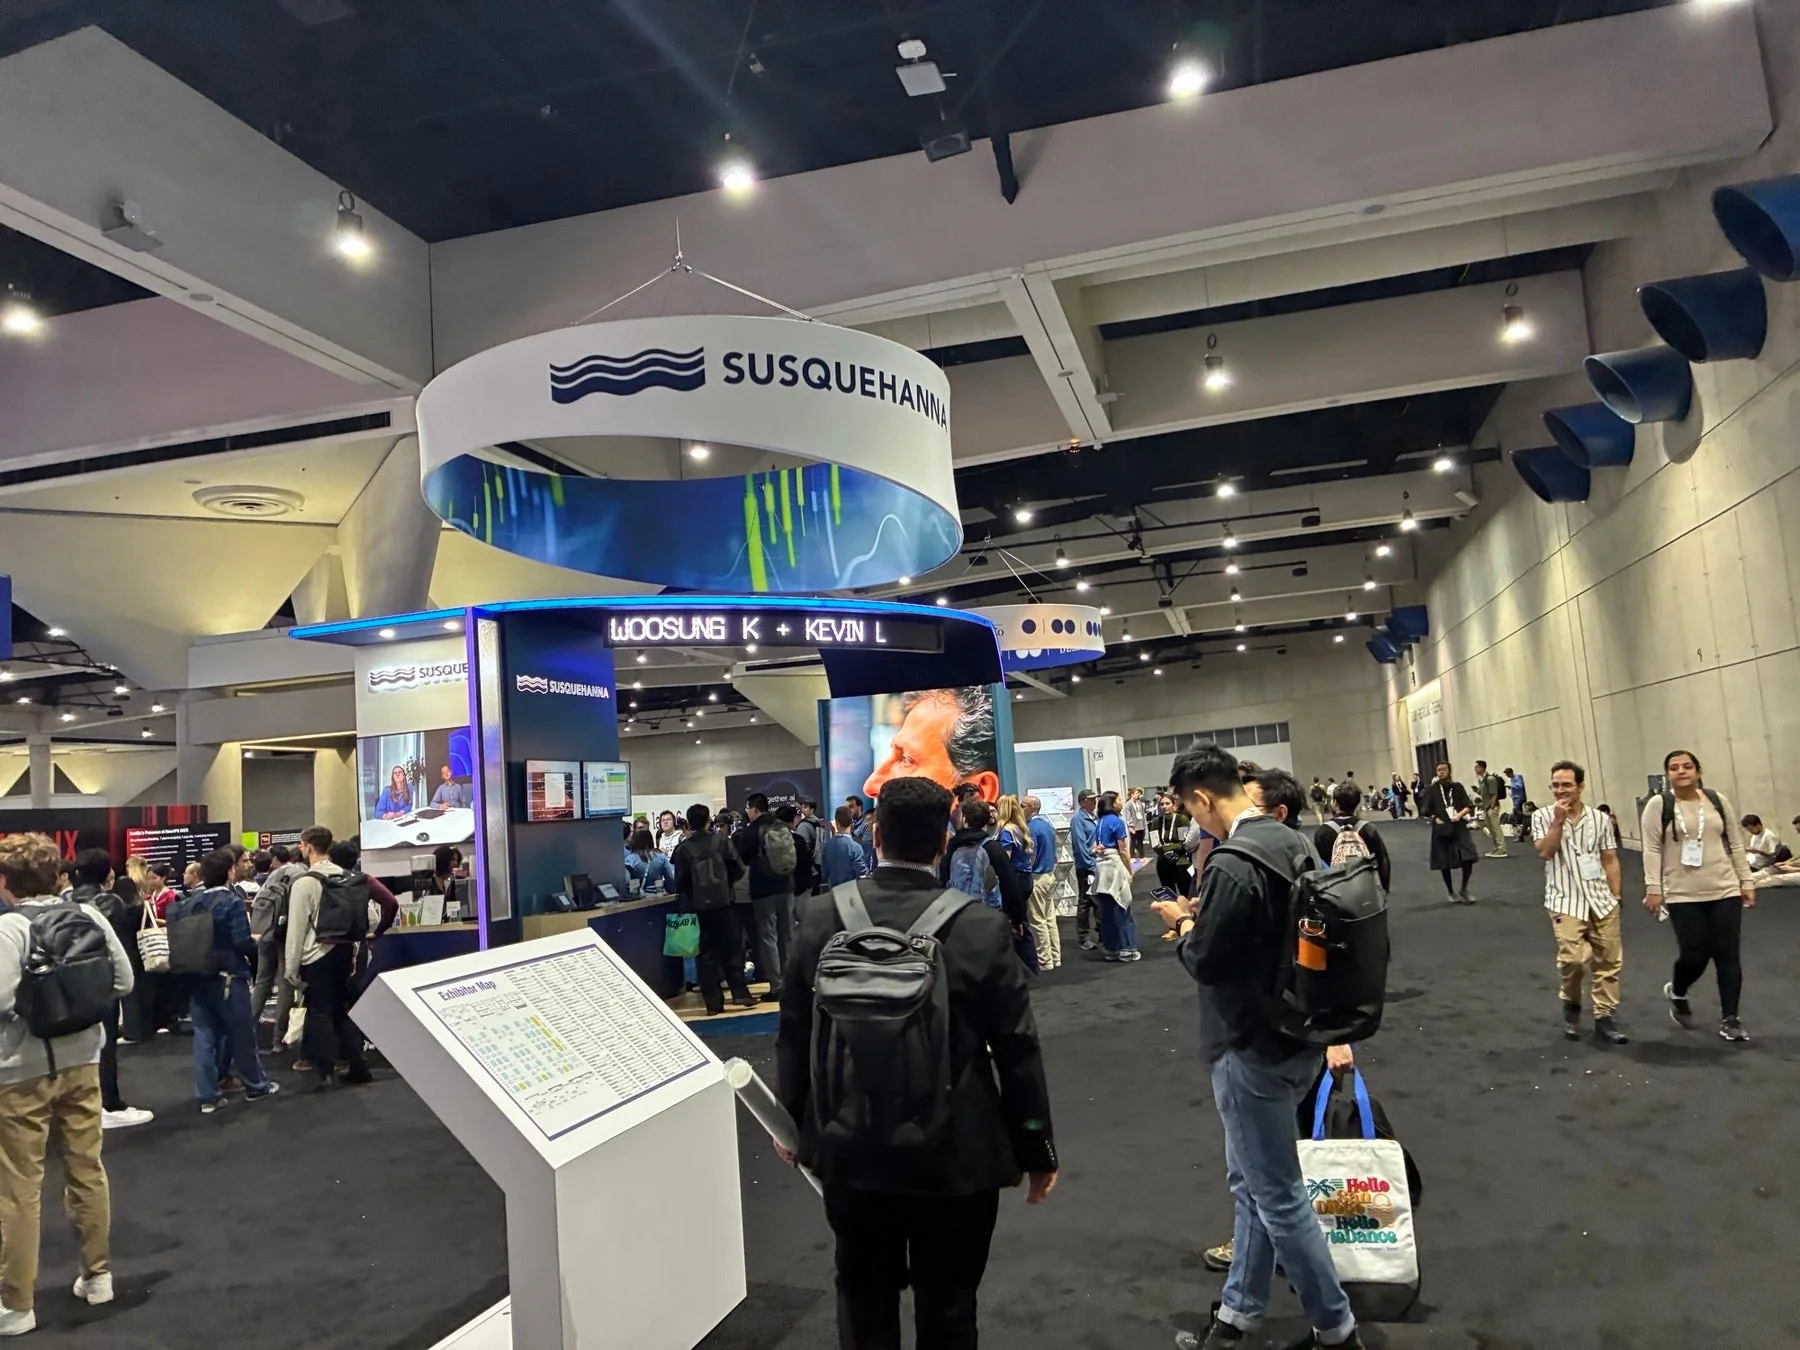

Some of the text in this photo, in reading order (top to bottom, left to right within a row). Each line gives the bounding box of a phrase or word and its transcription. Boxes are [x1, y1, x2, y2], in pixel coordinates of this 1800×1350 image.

[722, 351, 948, 432] SUSQUEHANNA
[610, 616, 726, 641] WOOSUNG
[742, 617, 760, 640] K
[805, 619, 864, 643] KEVIN
[875, 621, 887, 643] L
[550, 680, 609, 699] SUSQUEHANNA
[437, 981, 496, 1001] Exhibitor Map
[1345, 1176, 1390, 1193] Hello
[1337, 1190, 1372, 1204] San
